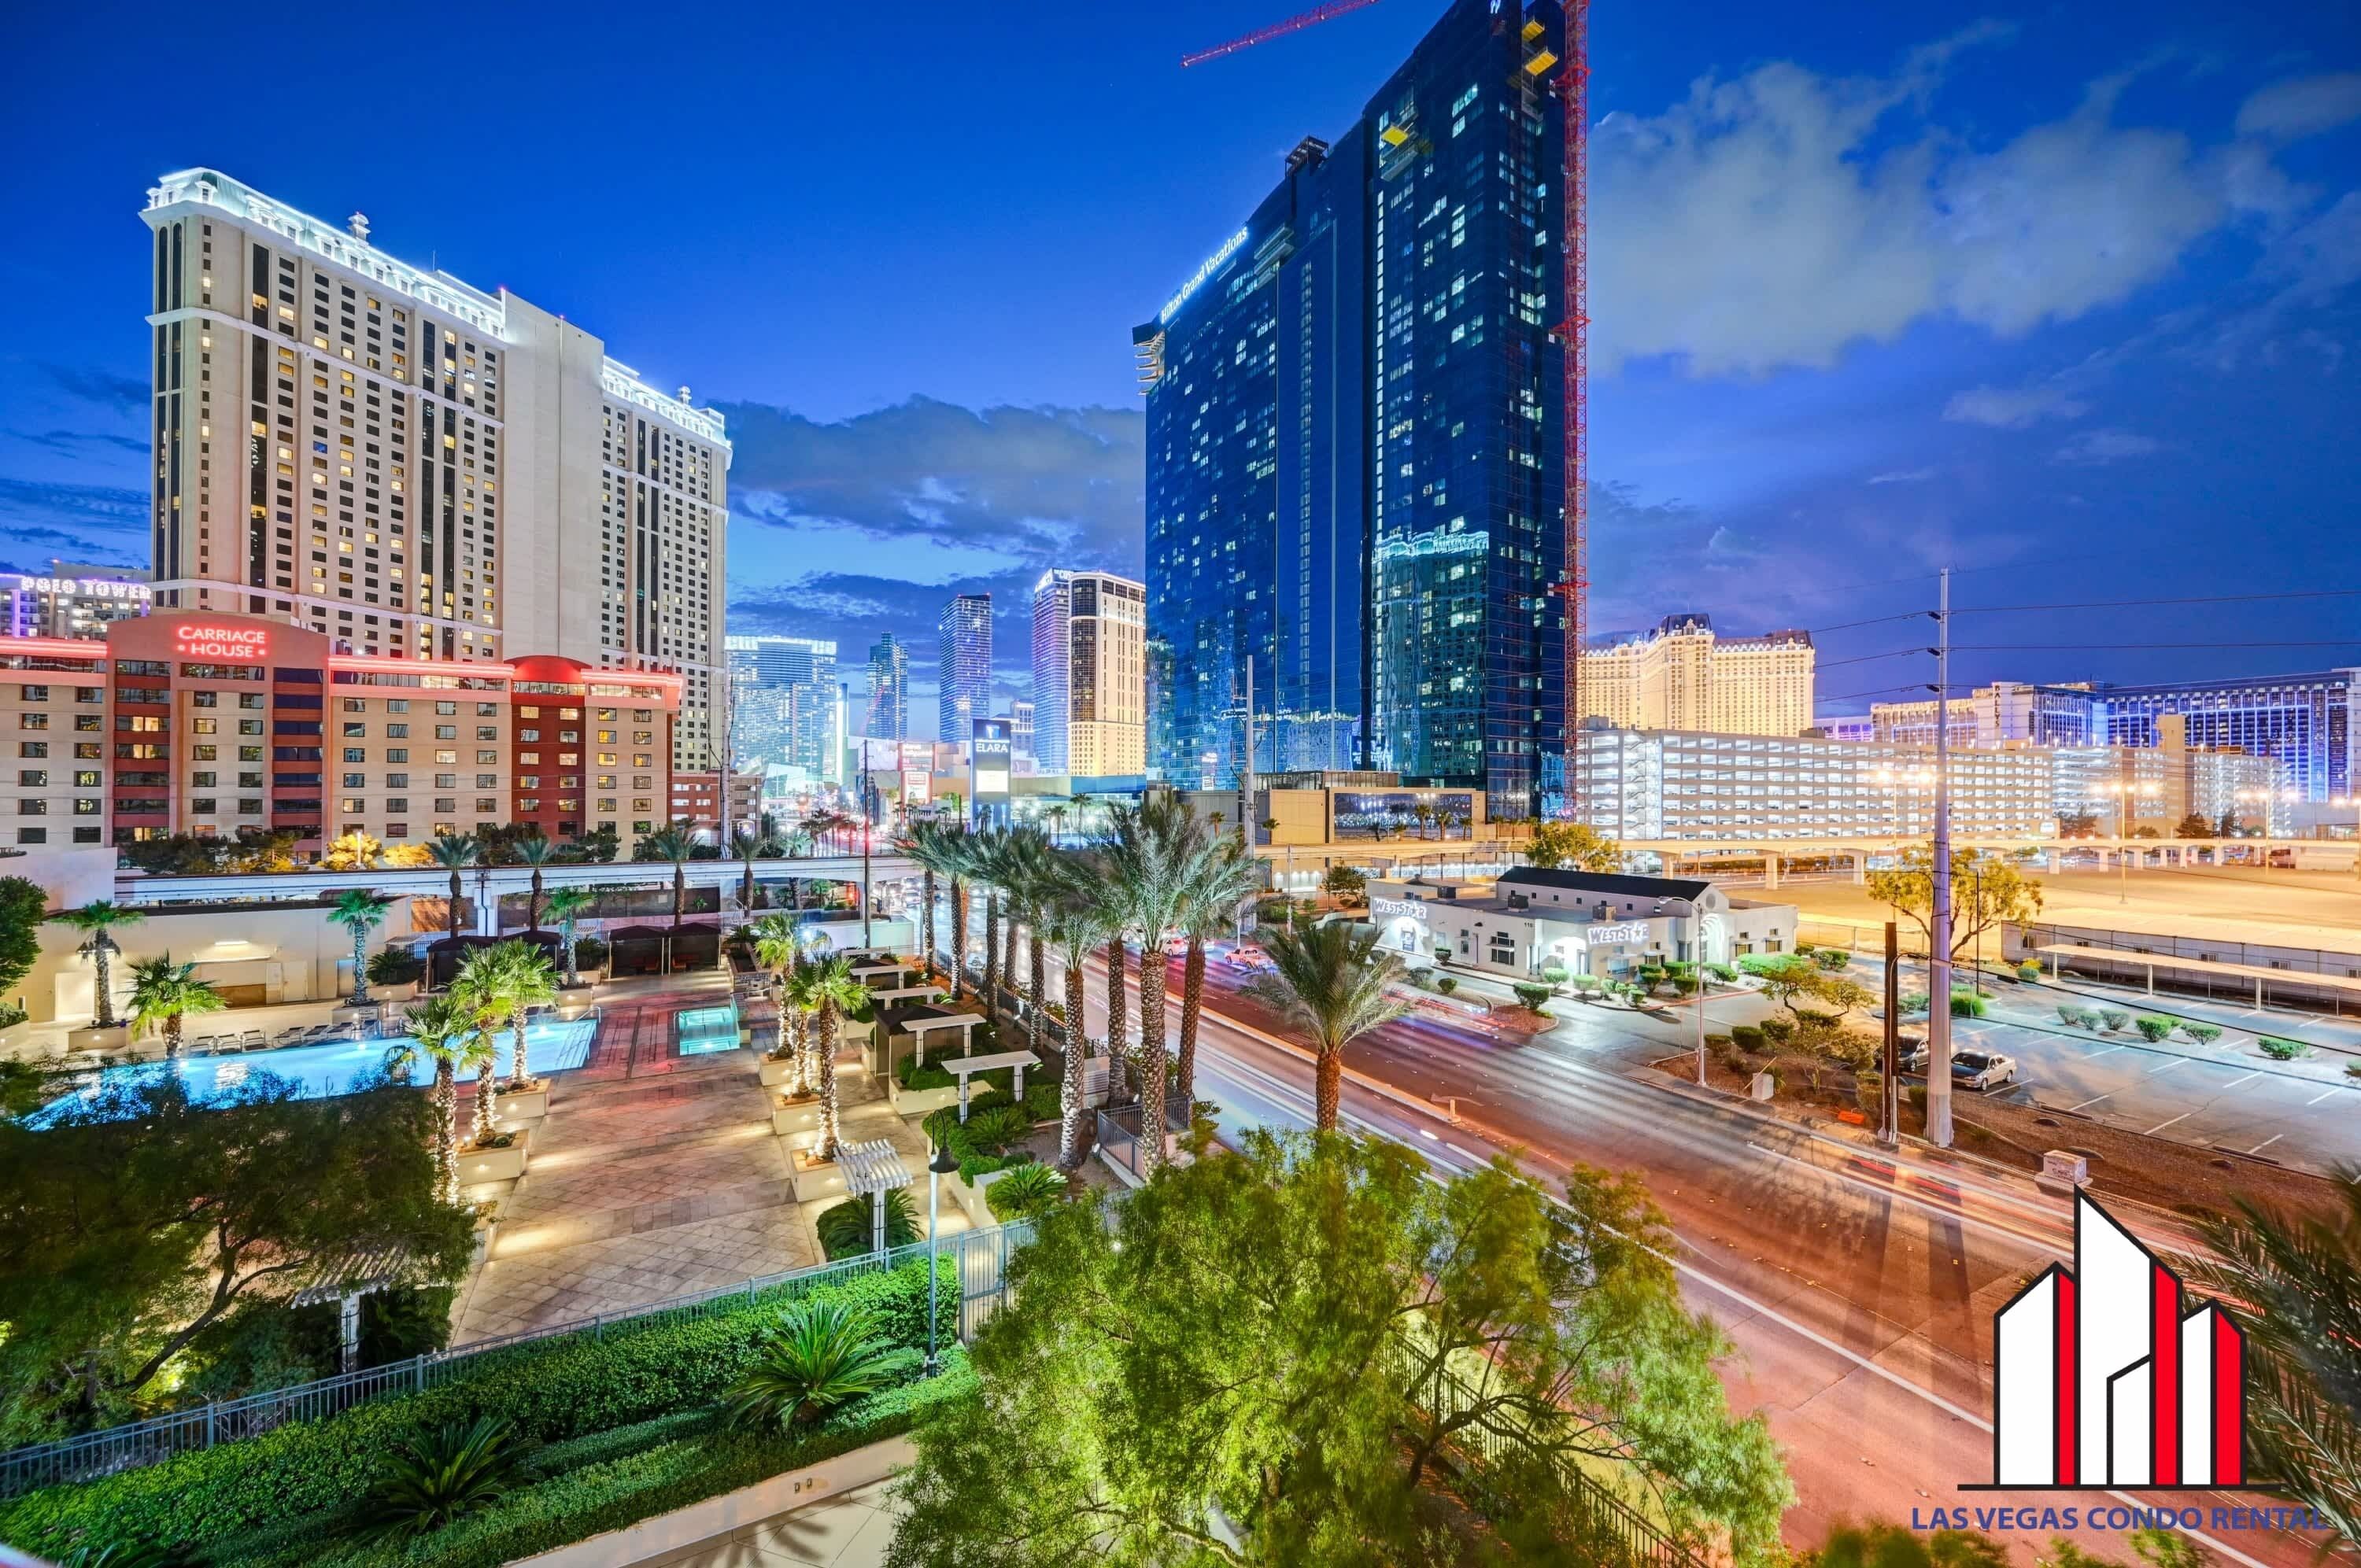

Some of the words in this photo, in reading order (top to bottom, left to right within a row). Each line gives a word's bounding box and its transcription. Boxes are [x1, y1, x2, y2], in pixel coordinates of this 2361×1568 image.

[1161, 293, 1182, 325] Hilton
[1183, 264, 1205, 298] Grand
[1206, 226, 1248, 275] Vacations
[20, 576, 77, 595] POLO
[178, 626, 265, 644] CARRIAGE
[190, 642, 254, 658] HOUSE
[975, 743, 1008, 753] ELARA
